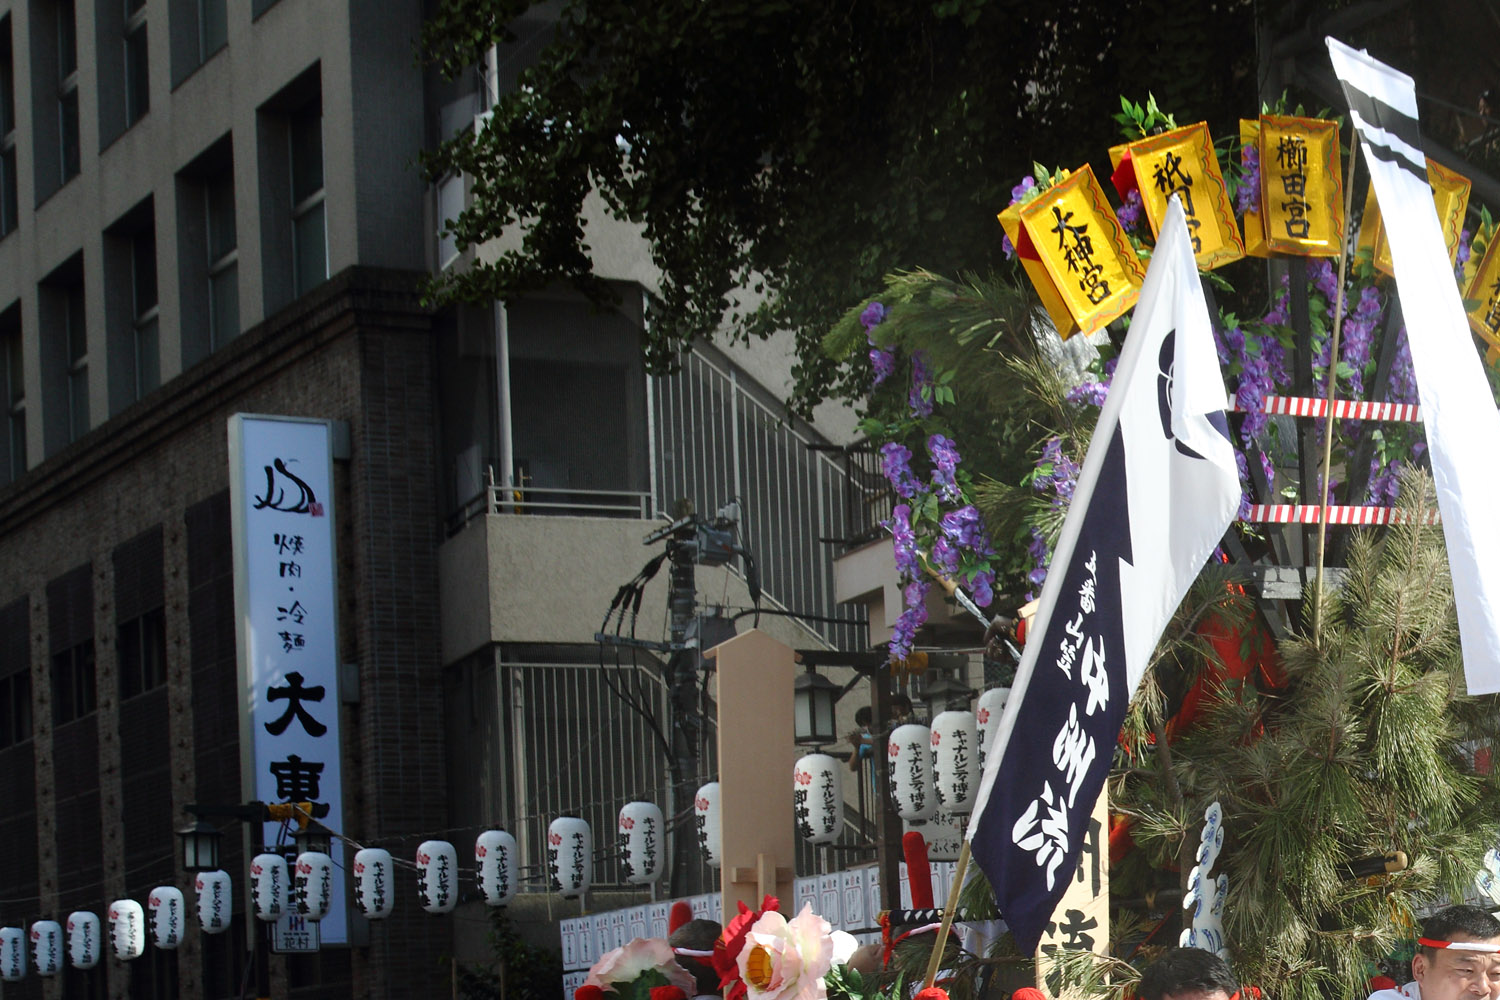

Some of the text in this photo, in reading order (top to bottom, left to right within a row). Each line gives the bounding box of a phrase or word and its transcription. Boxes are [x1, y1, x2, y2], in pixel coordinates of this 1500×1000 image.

[1275, 135, 1310, 240] 櫛田宮
[1051, 206, 1111, 305] 大神宮
[264, 670, 328, 914] 大東
[907, 742, 925, 811] キャナルシティ博多
[952, 729, 969, 803] キャナルシティ博多
[1012, 635, 1109, 892] 中洲流
[932, 842, 961, 853] ふくや
